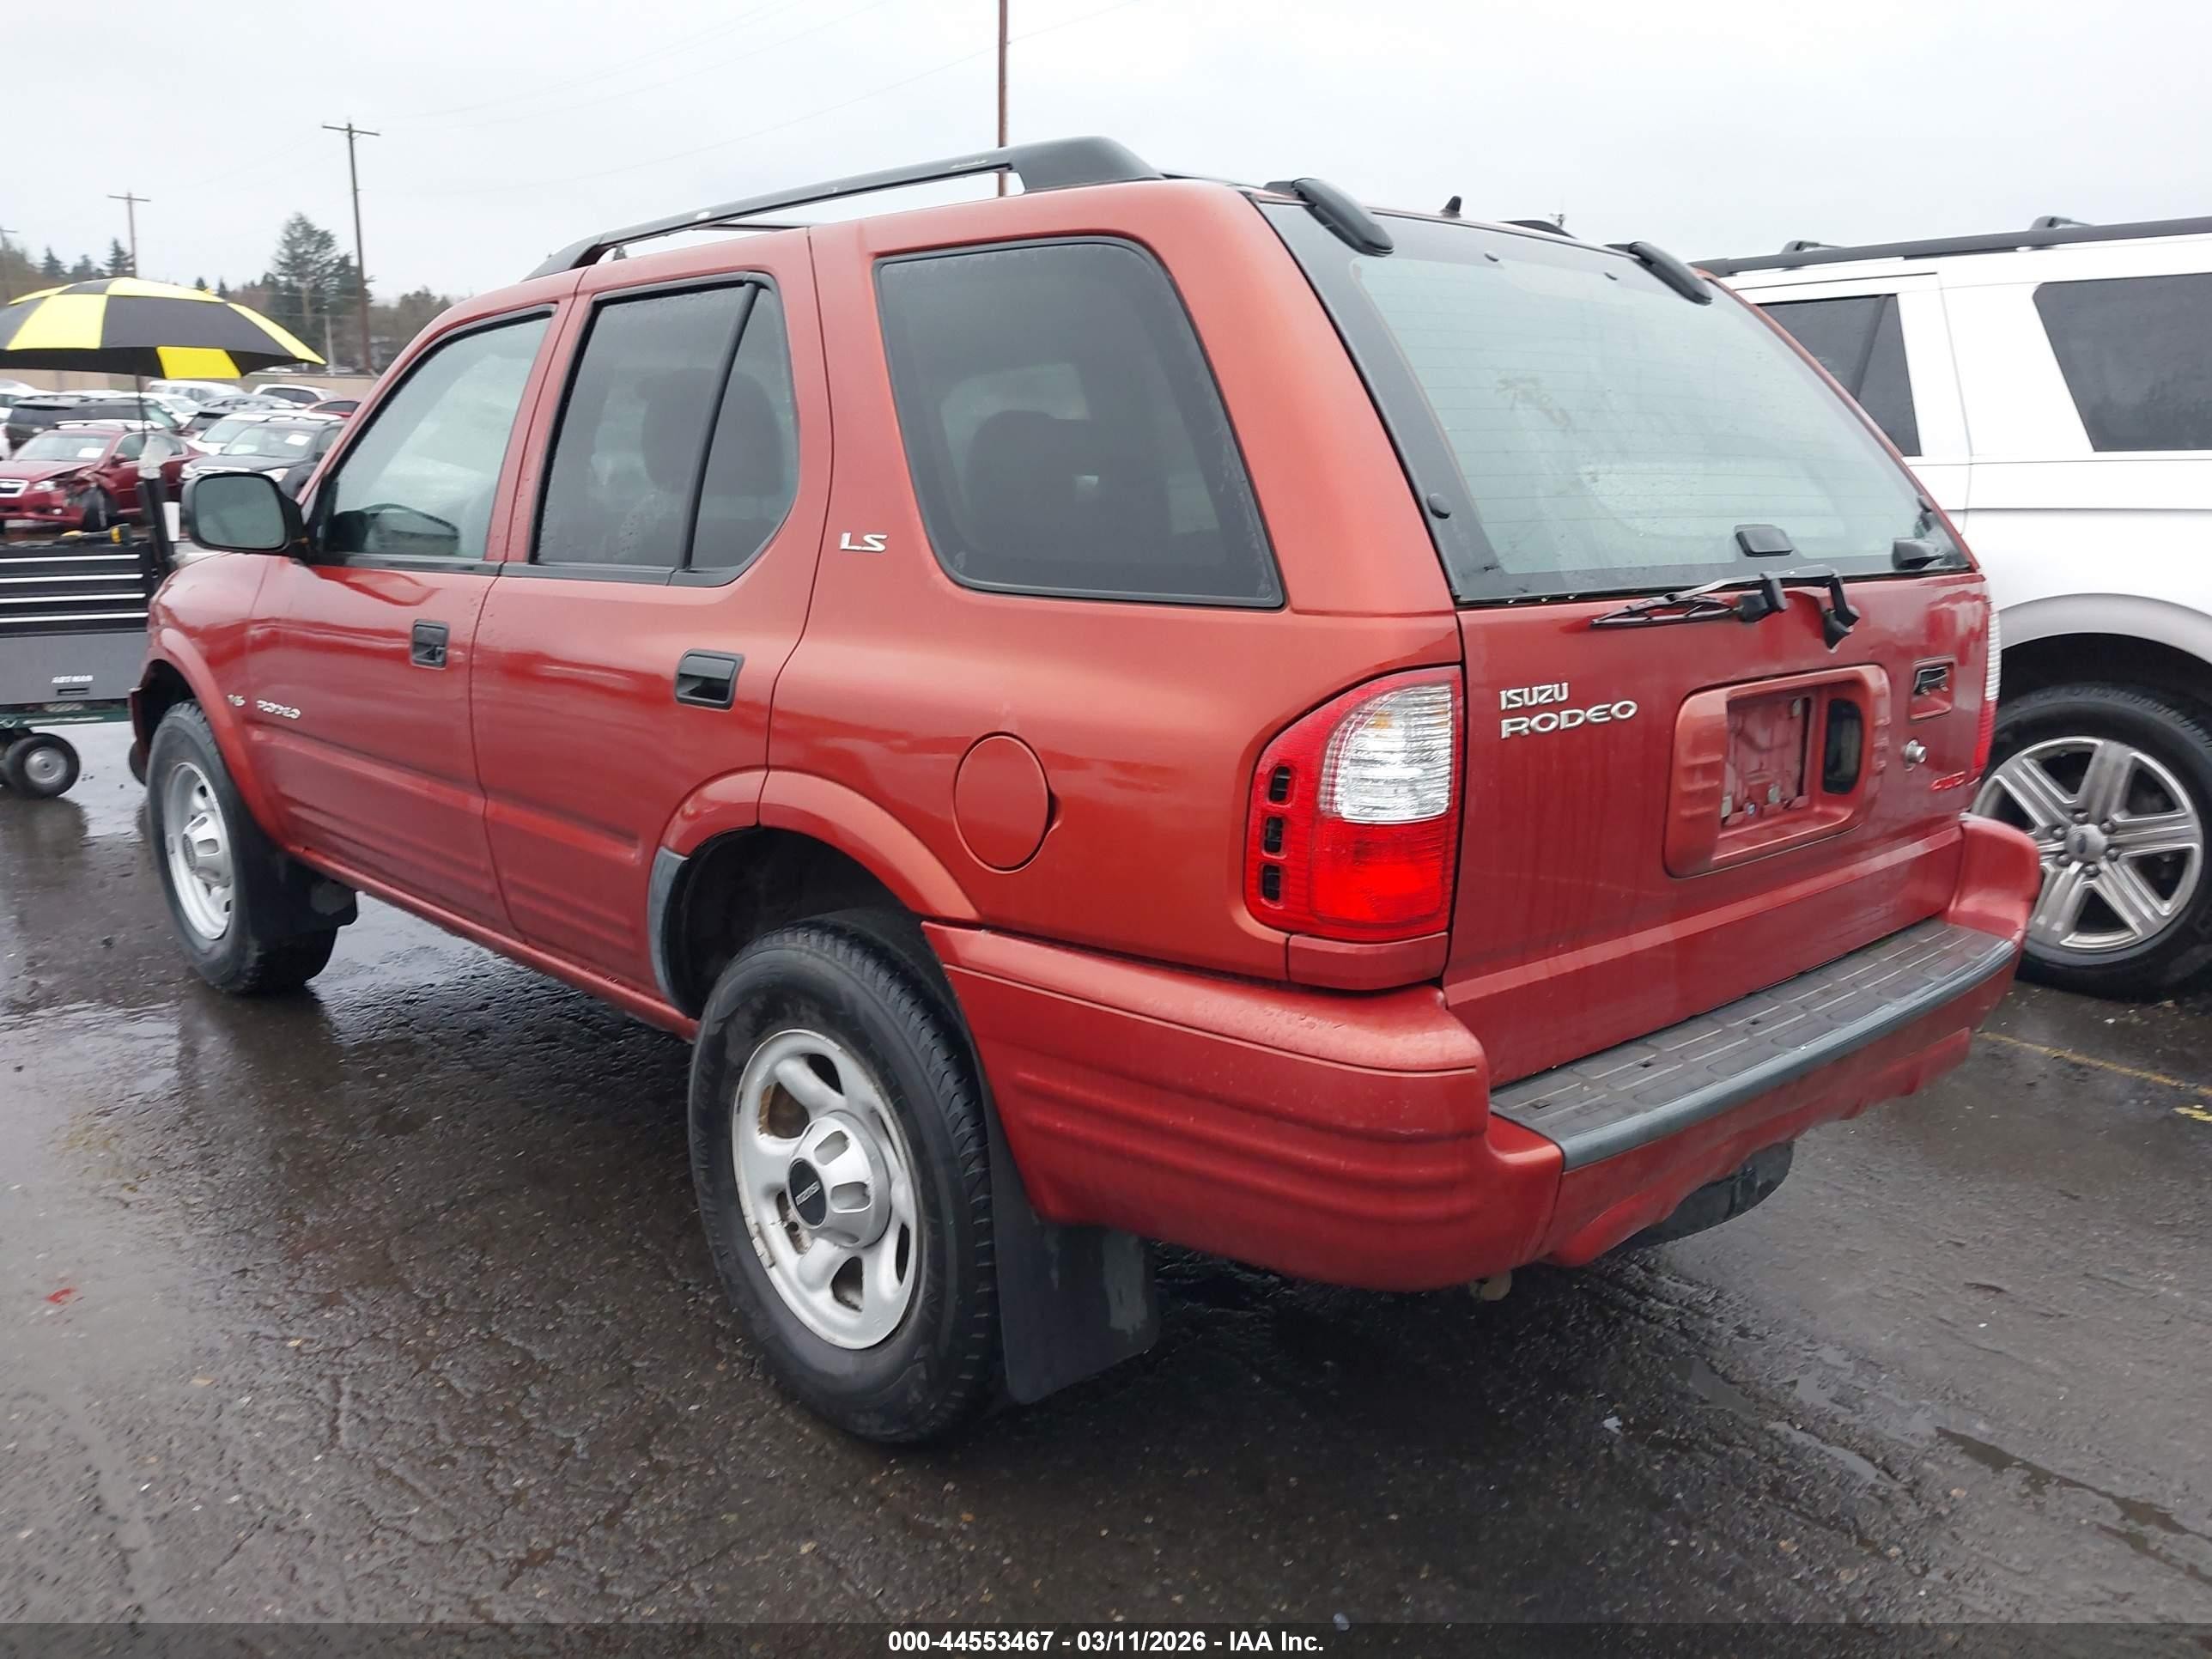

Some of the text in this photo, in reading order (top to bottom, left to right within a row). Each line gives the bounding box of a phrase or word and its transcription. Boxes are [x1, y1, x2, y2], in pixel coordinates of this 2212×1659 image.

[839, 532, 888, 552] LS
[1499, 682, 1570, 711] ISUZU
[1500, 700, 1638, 739] RODEO
